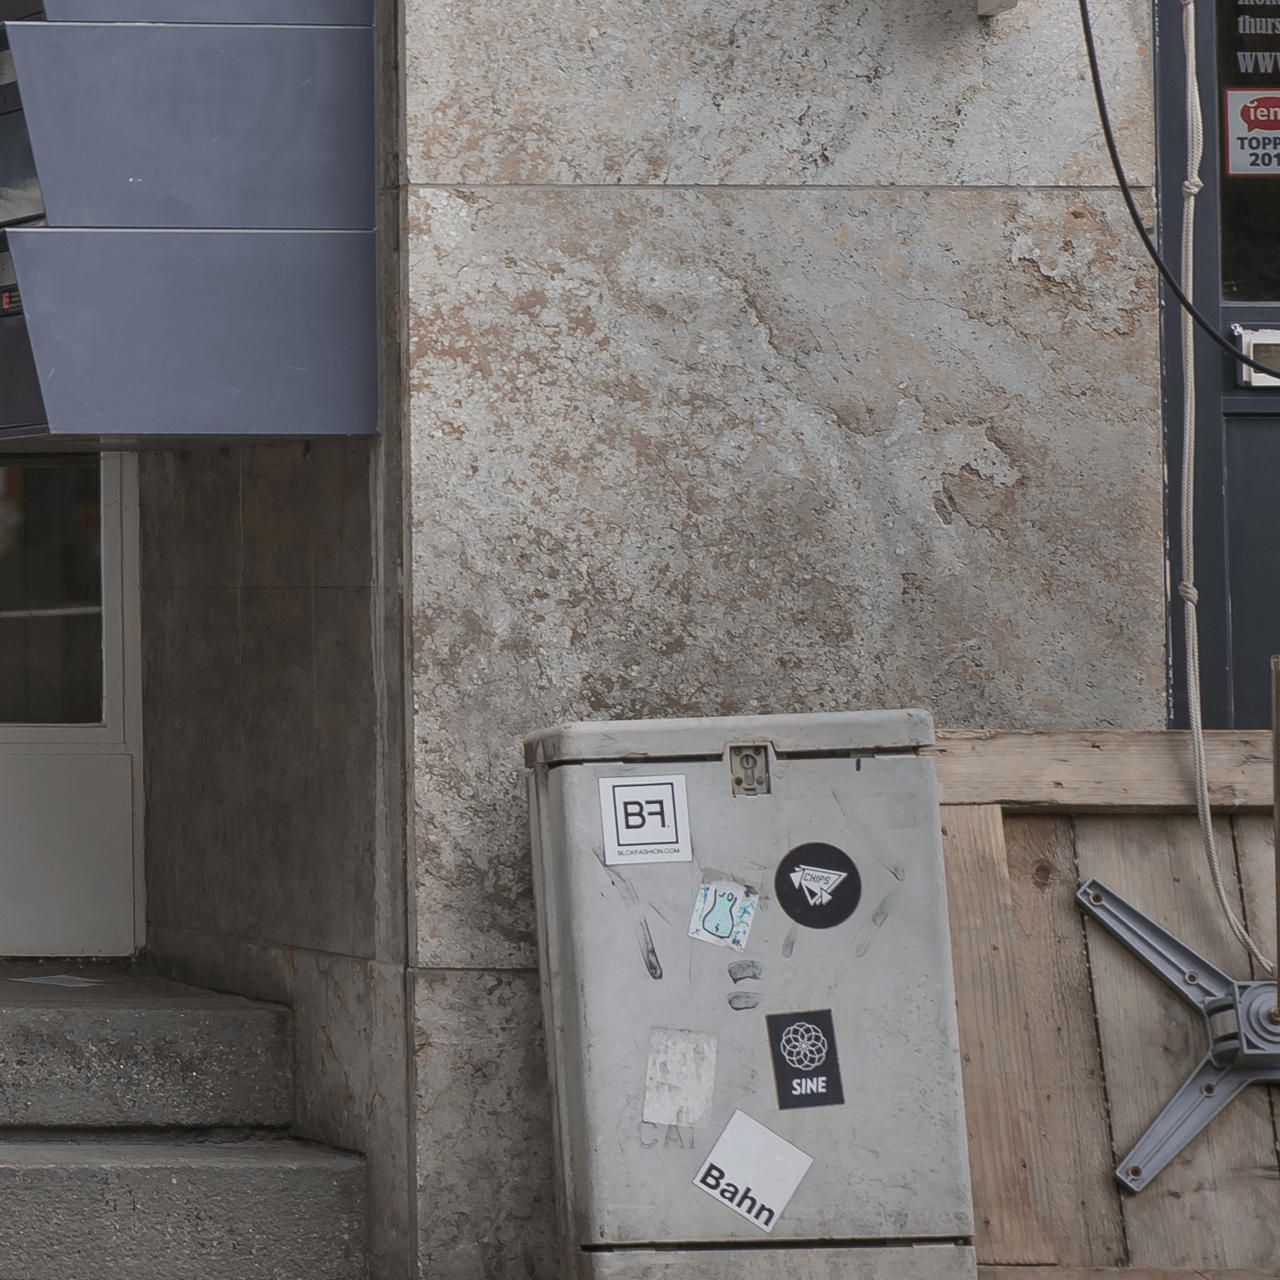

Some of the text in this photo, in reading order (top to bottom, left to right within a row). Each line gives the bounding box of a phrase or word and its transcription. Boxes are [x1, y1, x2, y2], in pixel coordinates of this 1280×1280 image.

[803, 872, 831, 886] CHIPS
[792, 1076, 828, 1096] SINE
[699, 1162, 776, 1228] Bahn
